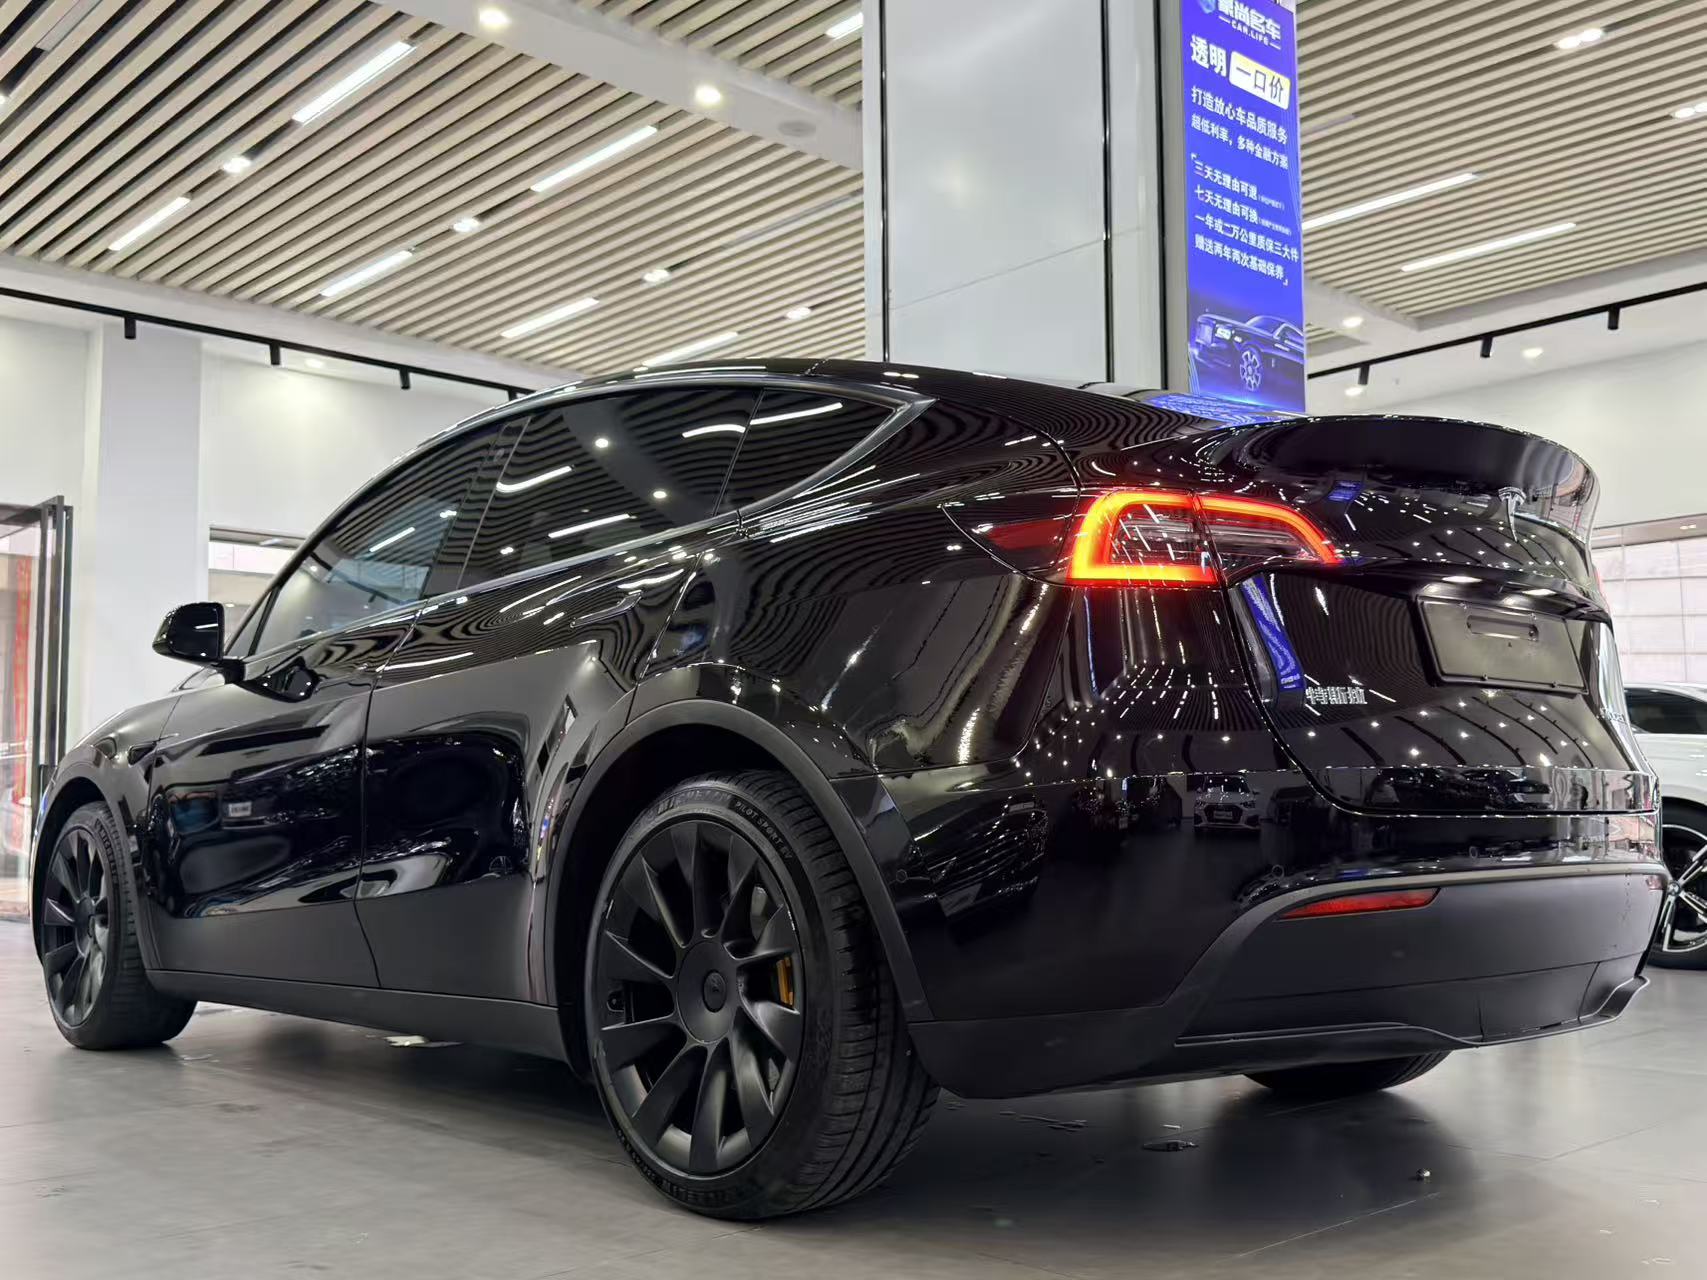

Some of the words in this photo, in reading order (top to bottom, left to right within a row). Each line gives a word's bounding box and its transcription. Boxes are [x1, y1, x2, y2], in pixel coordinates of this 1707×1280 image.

[1190, 34, 1227, 77] 透明
[1235, 66, 1284, 103] 一口价
[1191, 86, 1288, 145] 打造放心车品质服务
[1195, 184, 1259, 225] 七天无理由可换
[1195, 213, 1299, 263] 一年或二万公里质保三大件
[1305, 686, 1368, 705] 特斯拉
[734, 800, 758, 820] PILOT
[756, 818, 784, 846] SPORT
